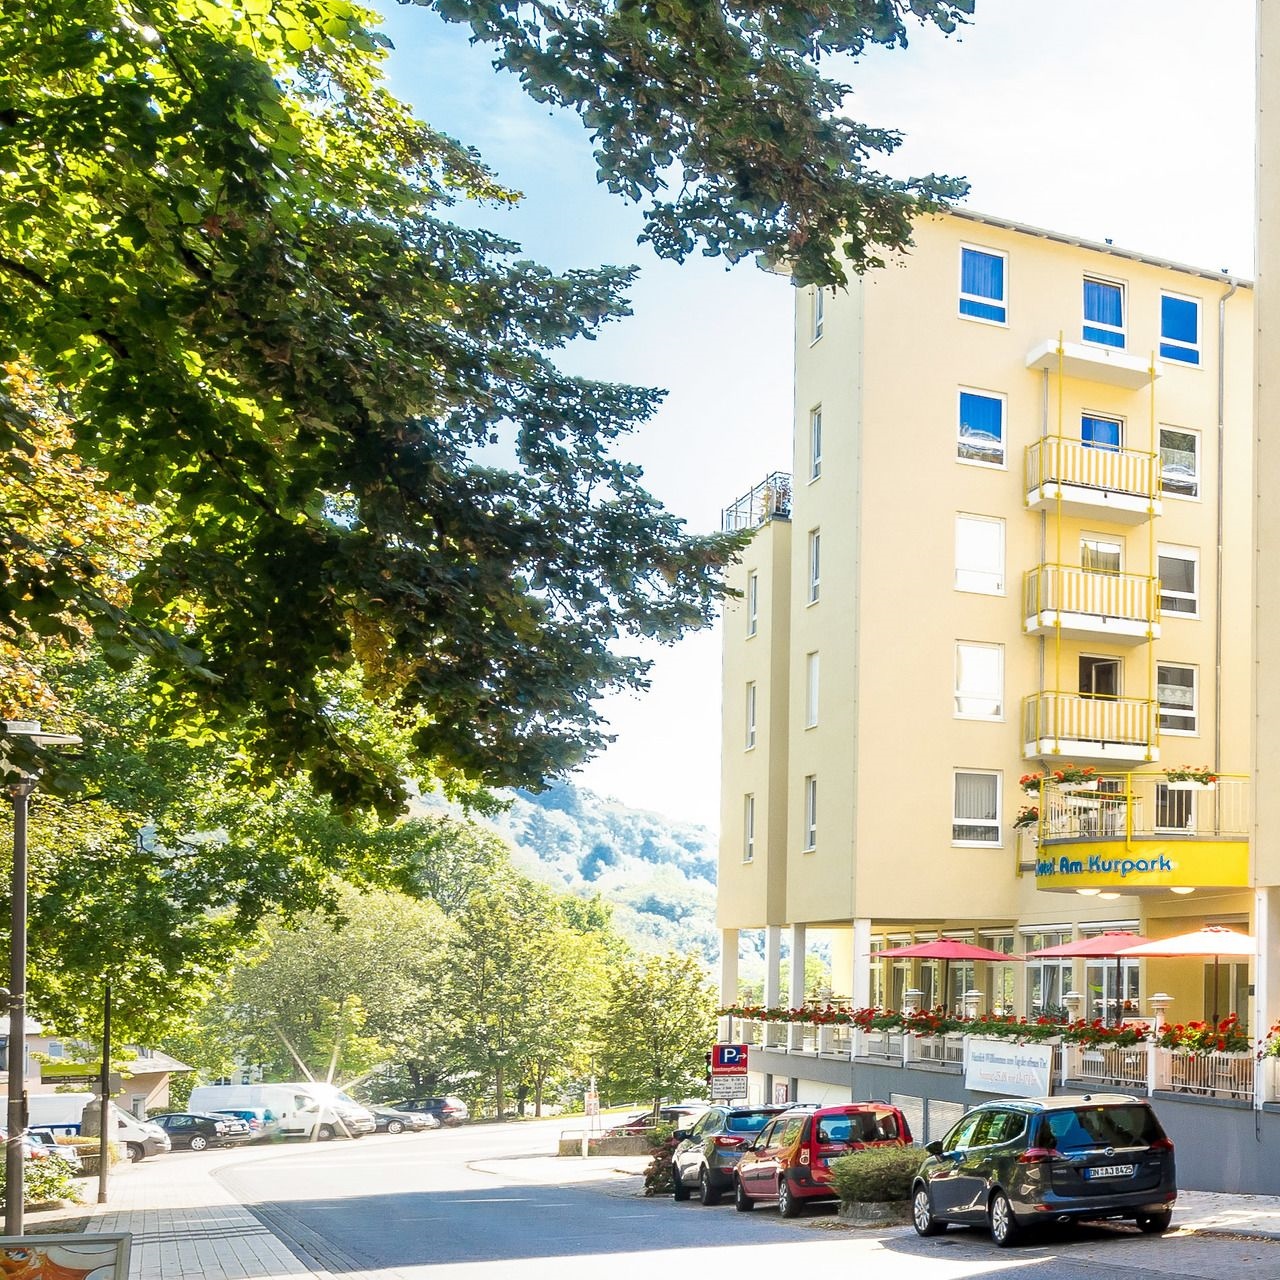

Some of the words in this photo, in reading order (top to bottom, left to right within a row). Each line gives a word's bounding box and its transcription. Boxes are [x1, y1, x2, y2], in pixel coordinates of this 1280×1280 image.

[1059, 856, 1083, 874] Am
[1087, 854, 1172, 878] Kurpark
[724, 1048, 736, 1062] P
